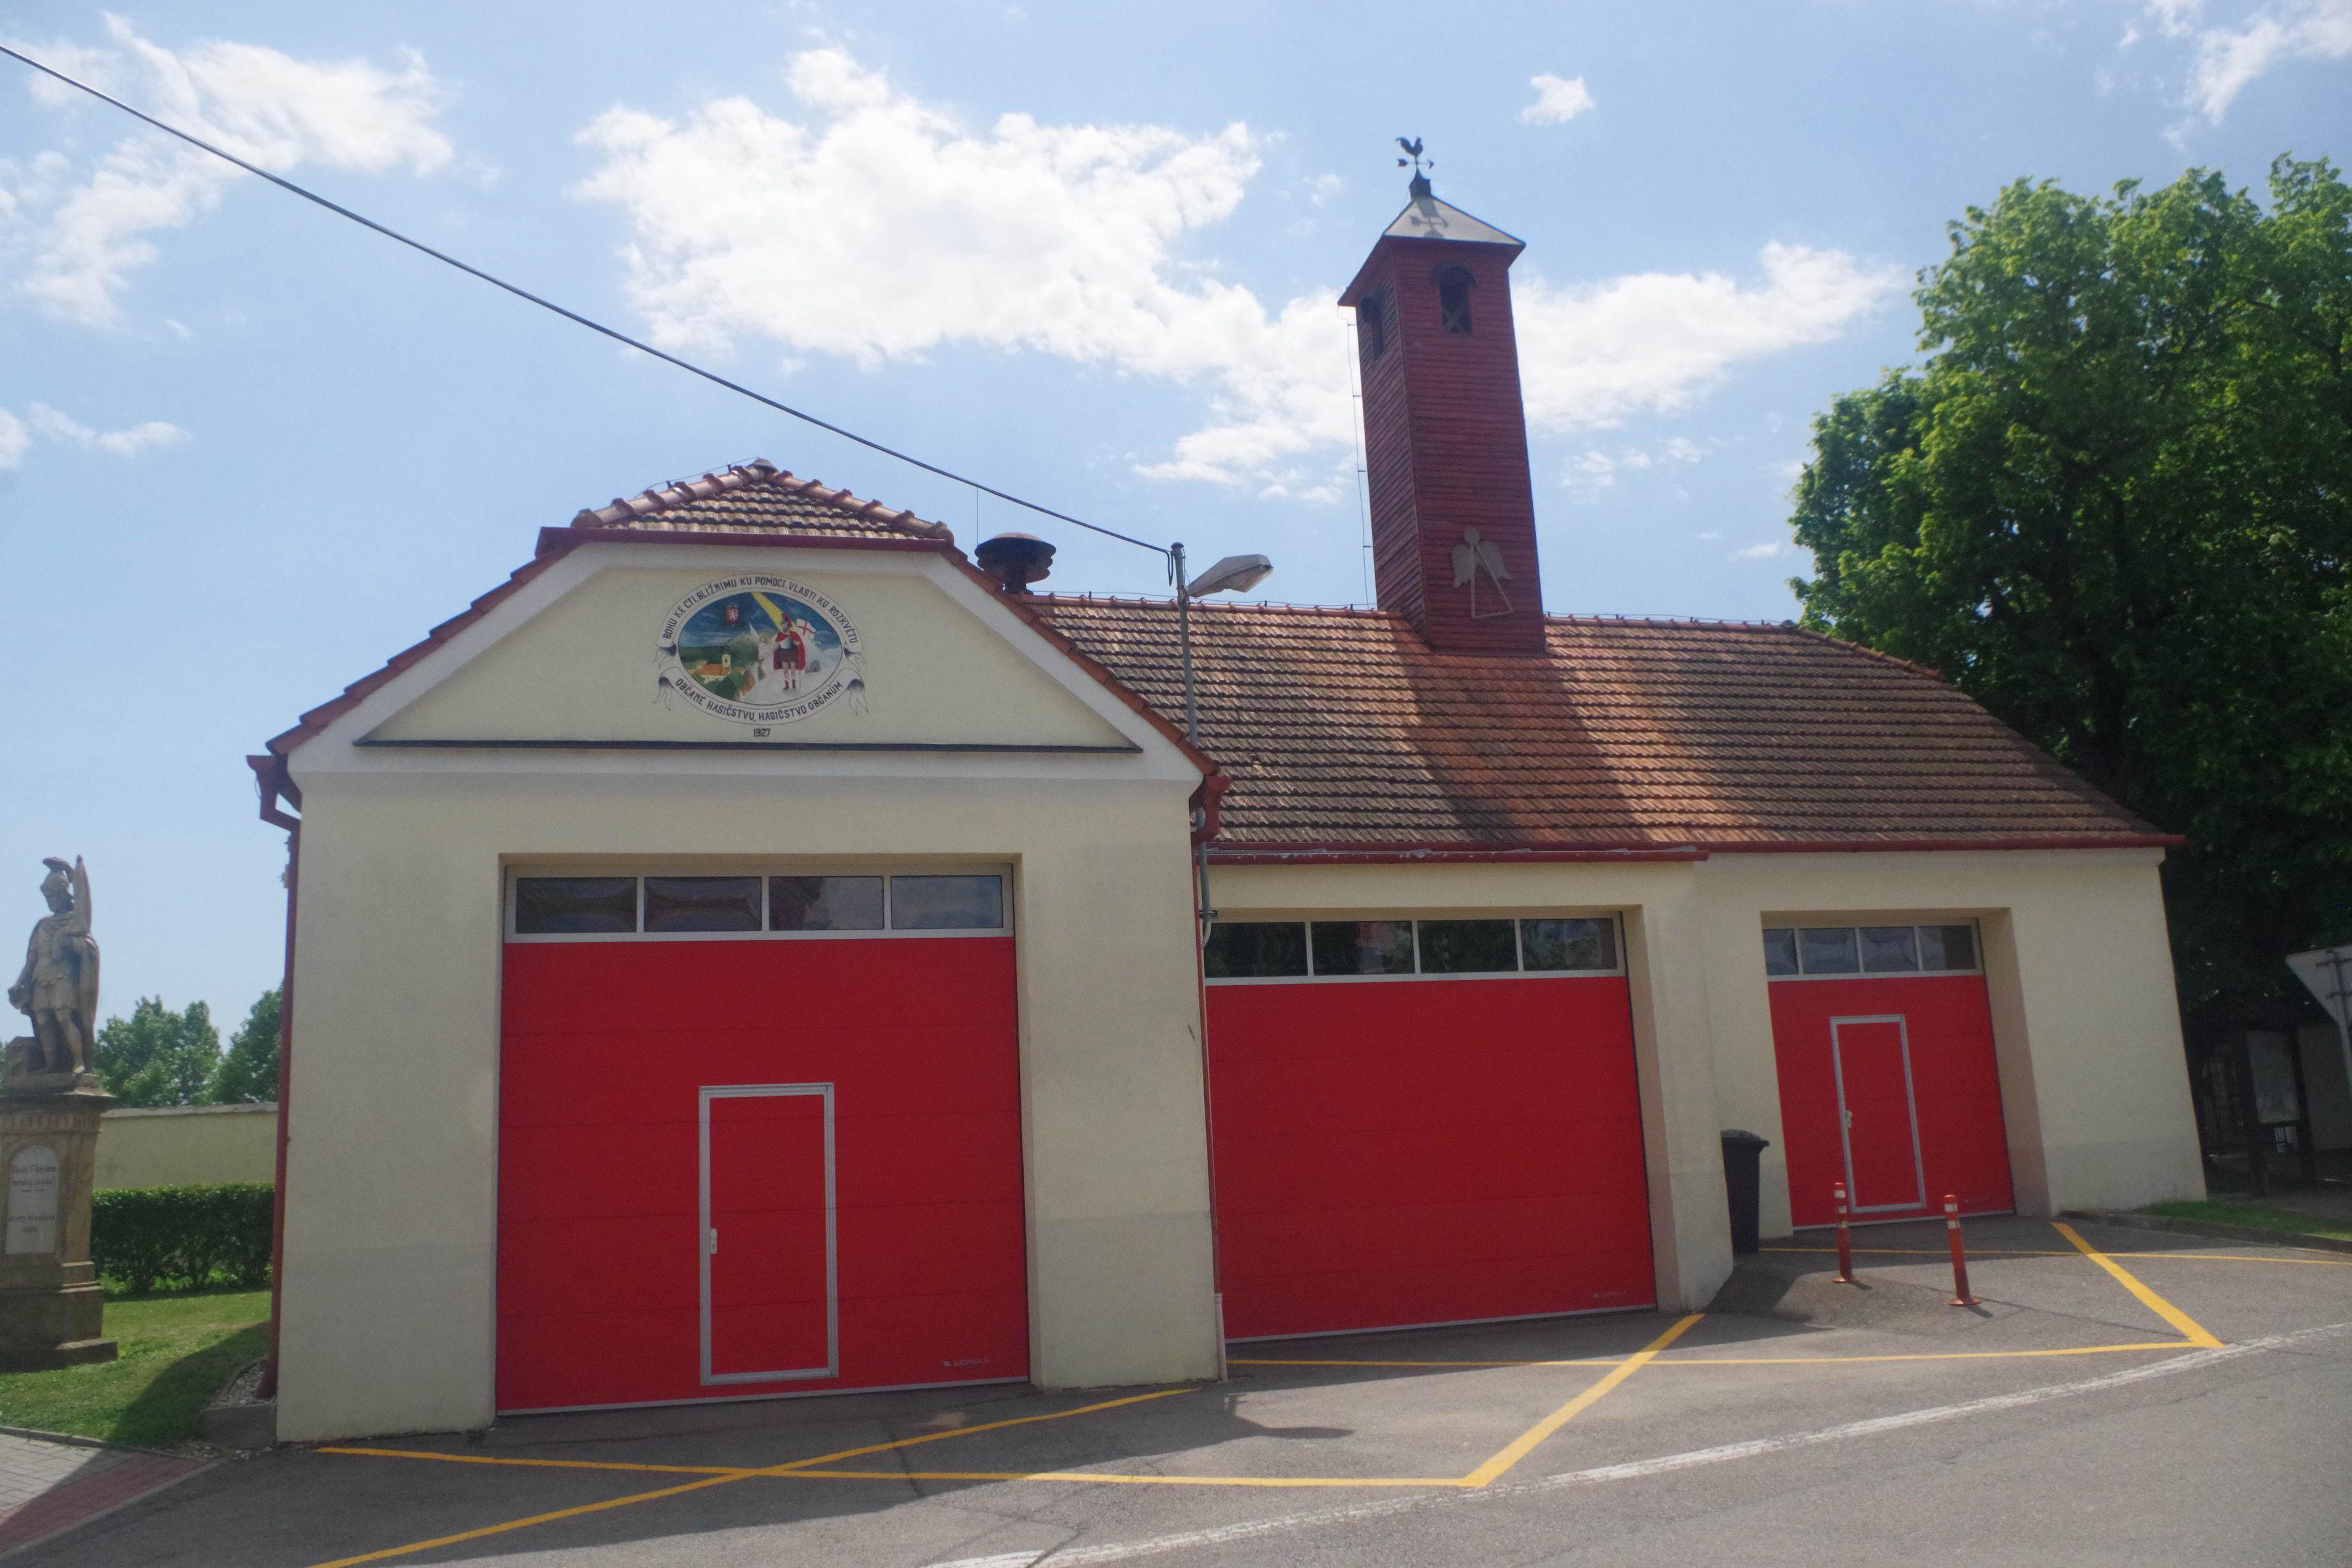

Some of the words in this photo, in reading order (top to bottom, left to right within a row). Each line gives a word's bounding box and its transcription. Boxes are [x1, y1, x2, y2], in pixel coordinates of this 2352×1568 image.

[662, 618, 678, 639] BOHU
[673, 606, 686, 619] KE
[740, 577, 752, 586] KU
[789, 581, 817, 600] VLASTI
[817, 596, 830, 608] KU
[759, 706, 808, 722] HASIČSTVO
[954, 1358, 990, 1366] LOMAX
